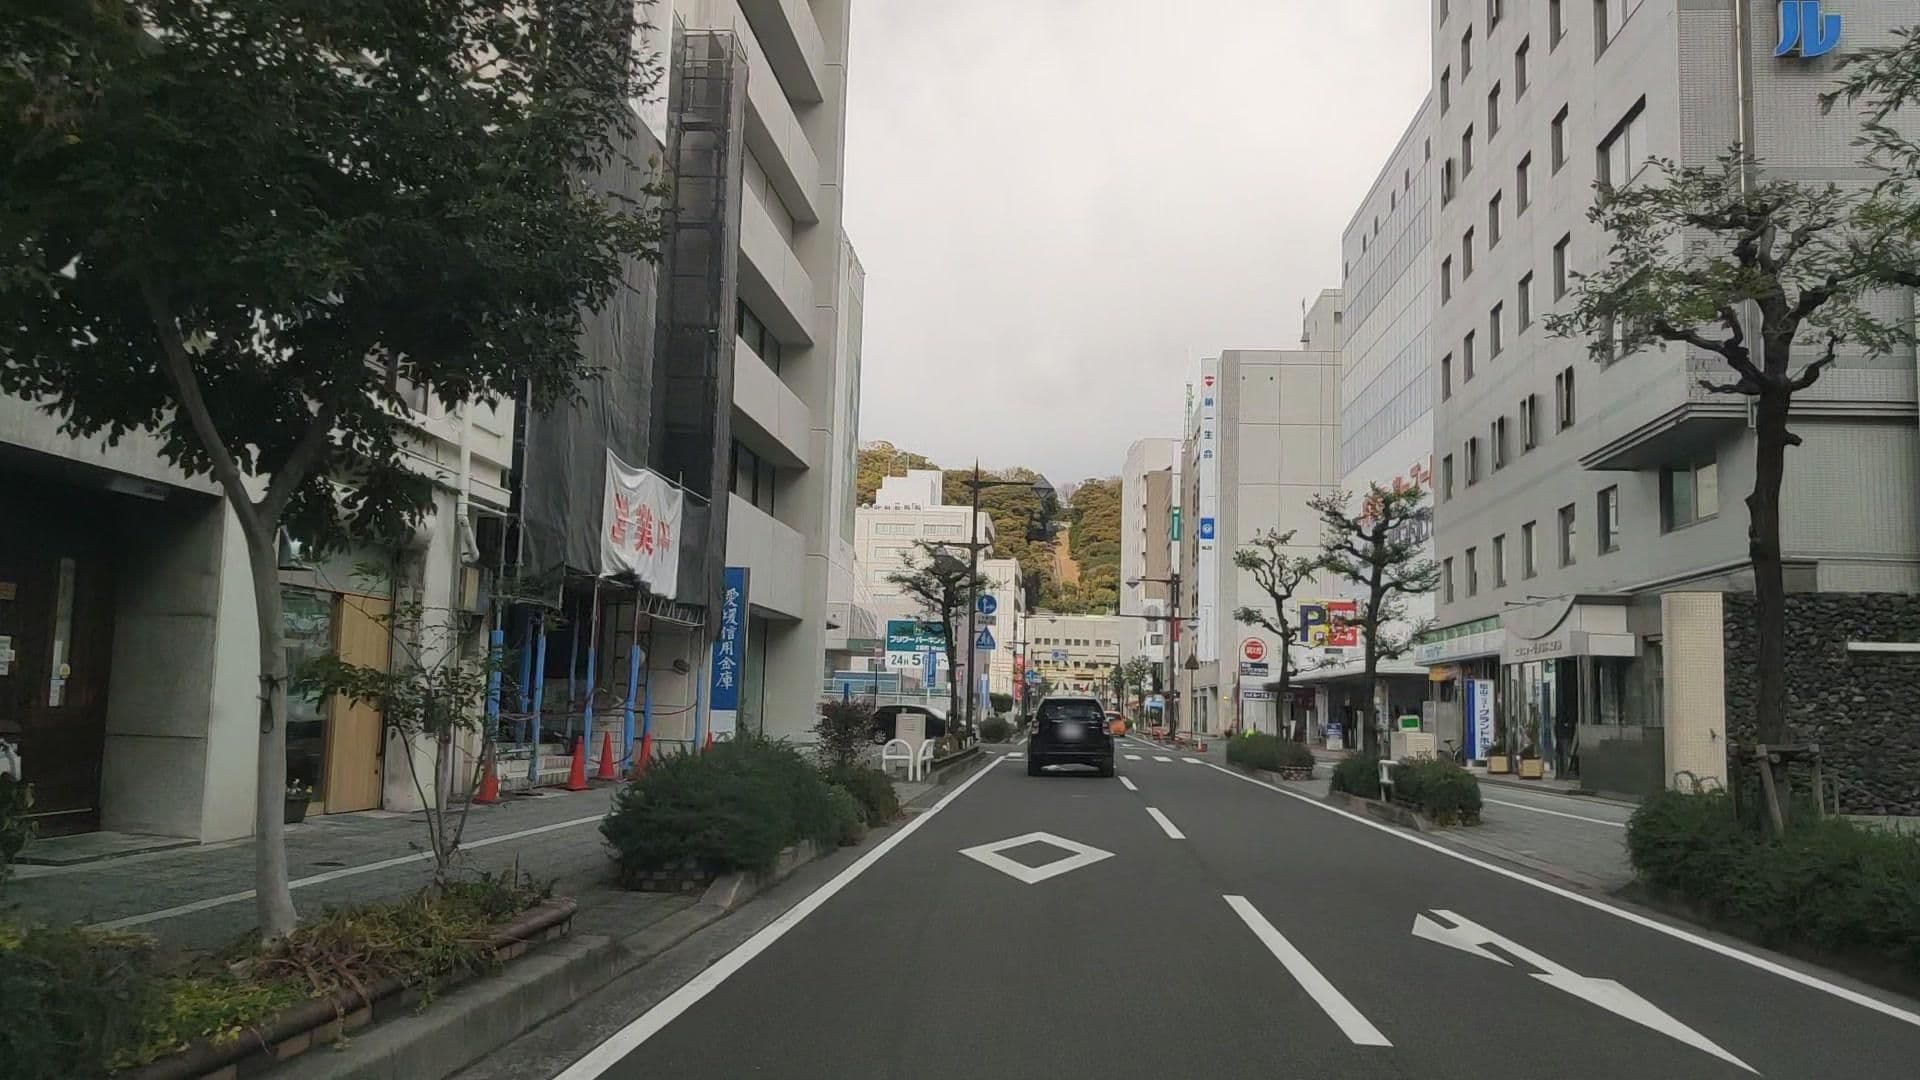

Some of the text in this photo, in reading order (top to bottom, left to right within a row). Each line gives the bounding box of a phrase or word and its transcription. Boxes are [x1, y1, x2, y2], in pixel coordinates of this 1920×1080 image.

[1775, 0, 1841, 57] ル
[1203, 397, 1214, 459] 第一生命
[610, 492, 672, 561] 営業中
[715, 587, 739, 690] 愛媛信用金庫
[1300, 605, 1327, 642] P
